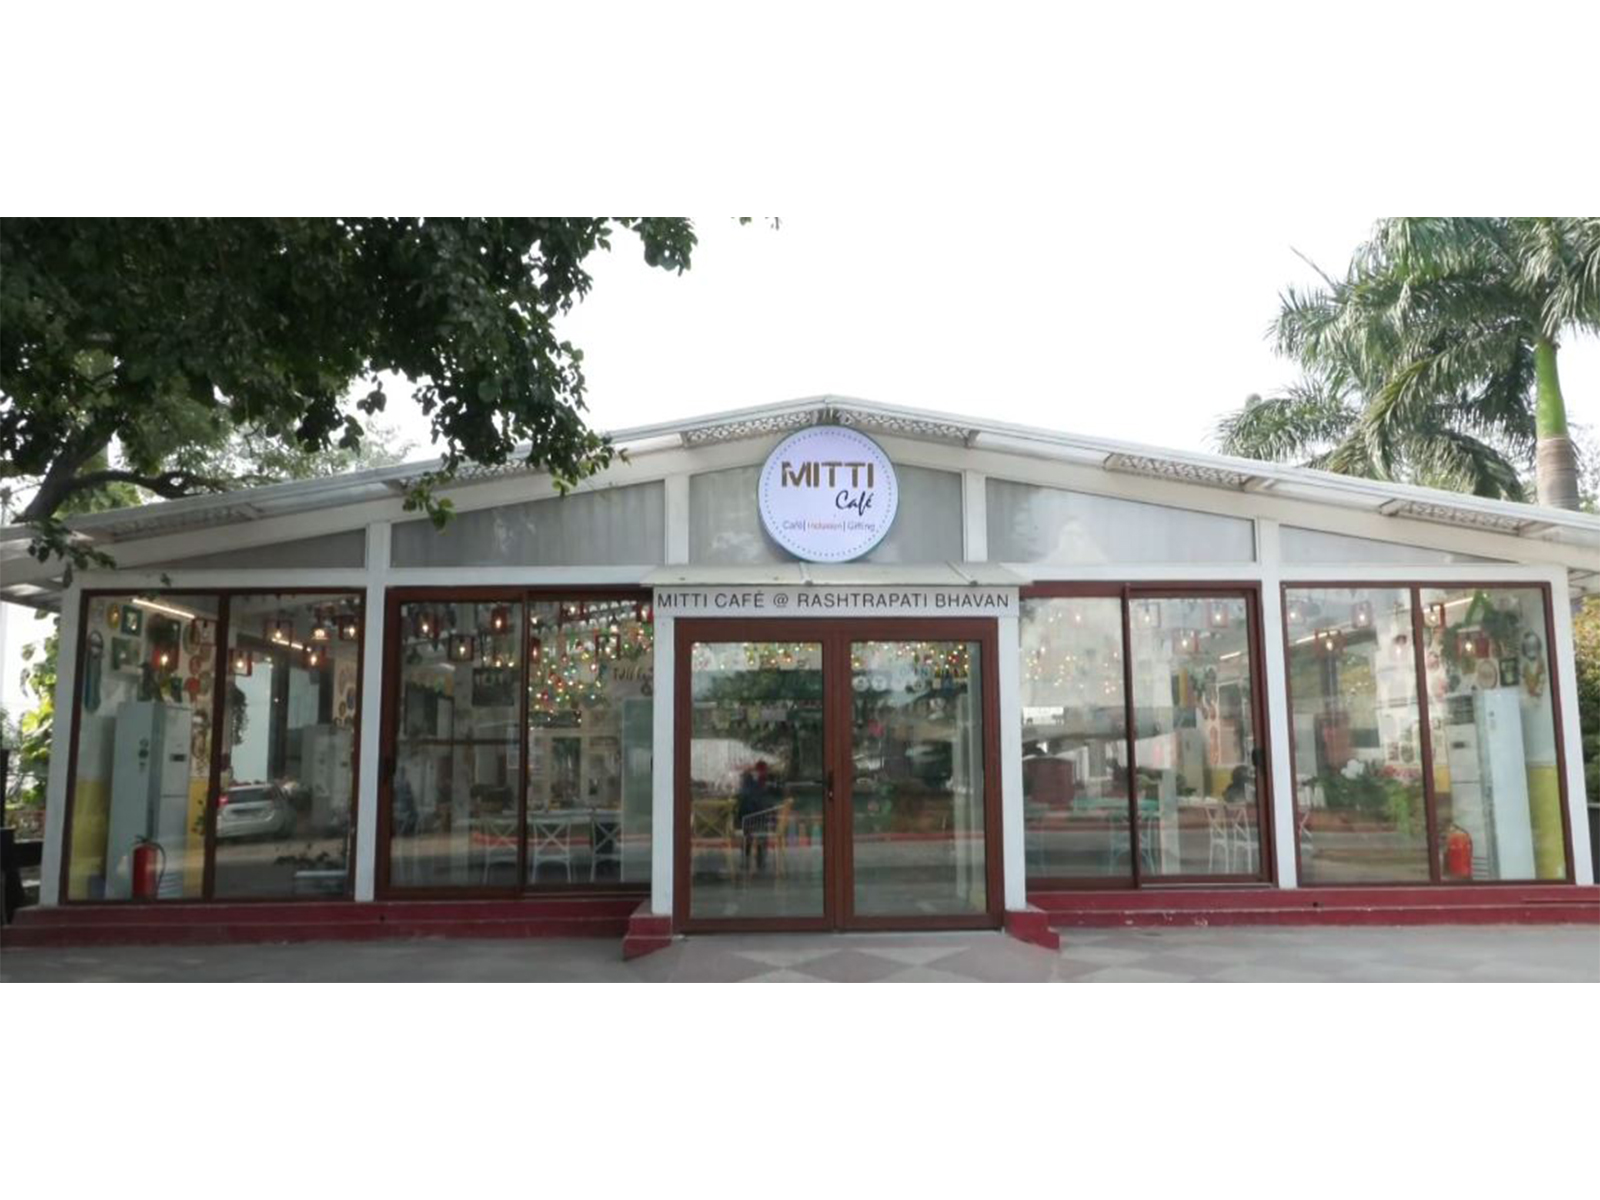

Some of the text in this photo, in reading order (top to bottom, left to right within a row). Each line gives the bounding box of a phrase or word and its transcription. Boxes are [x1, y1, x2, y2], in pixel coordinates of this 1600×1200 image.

[781, 461, 874, 488] MITTI
[835, 489, 874, 516] Café
[657, 590, 1008, 608] MITTI CAFÉ @ RASHTRAPATI BHAVAN
